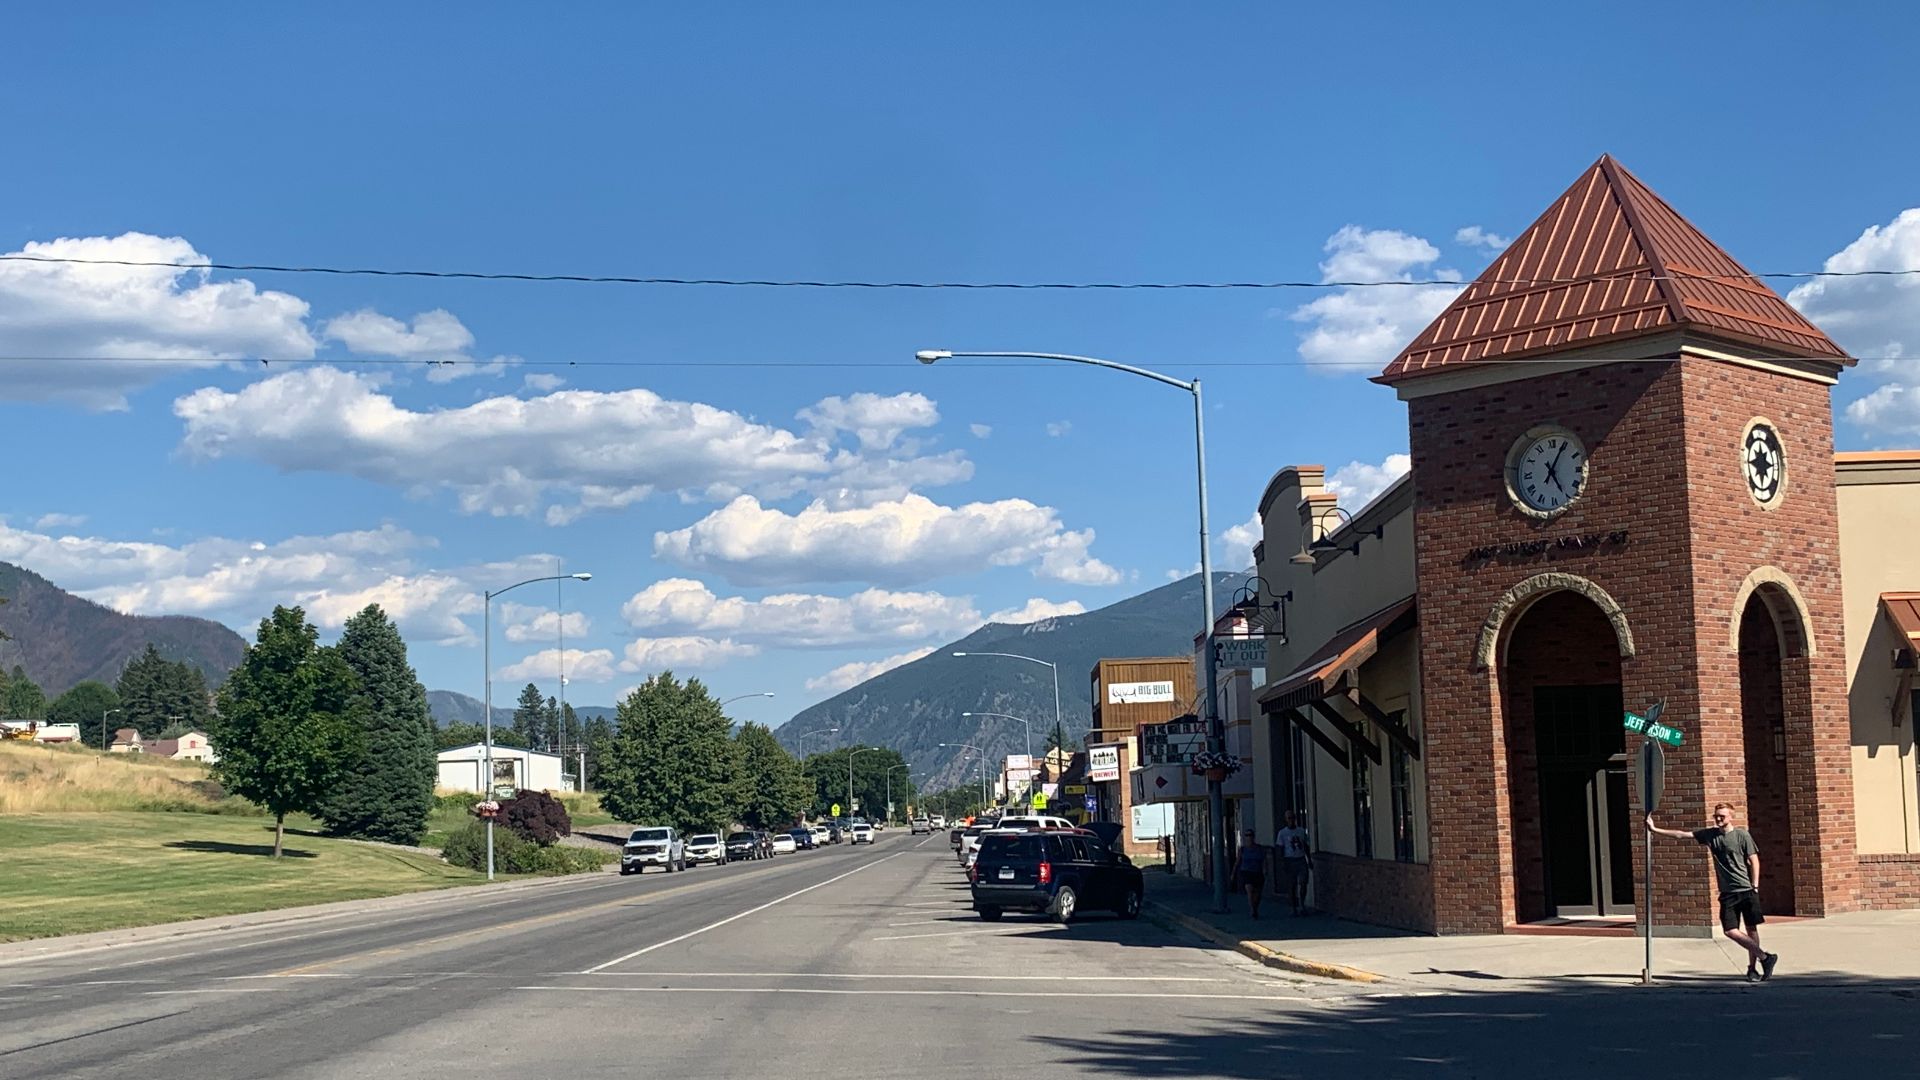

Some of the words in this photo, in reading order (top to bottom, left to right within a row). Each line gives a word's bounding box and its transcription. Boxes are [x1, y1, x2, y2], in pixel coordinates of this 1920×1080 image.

[1225, 640, 1266, 651] WORK
[1223, 652, 1235, 661] IT
[1240, 650, 1267, 661] OUT
[1138, 685, 1151, 695] BIG
[1153, 684, 1171, 695] BULL
[1624, 716, 1671, 740] JEFFERSON
[1093, 770, 1117, 779] BREWERY
